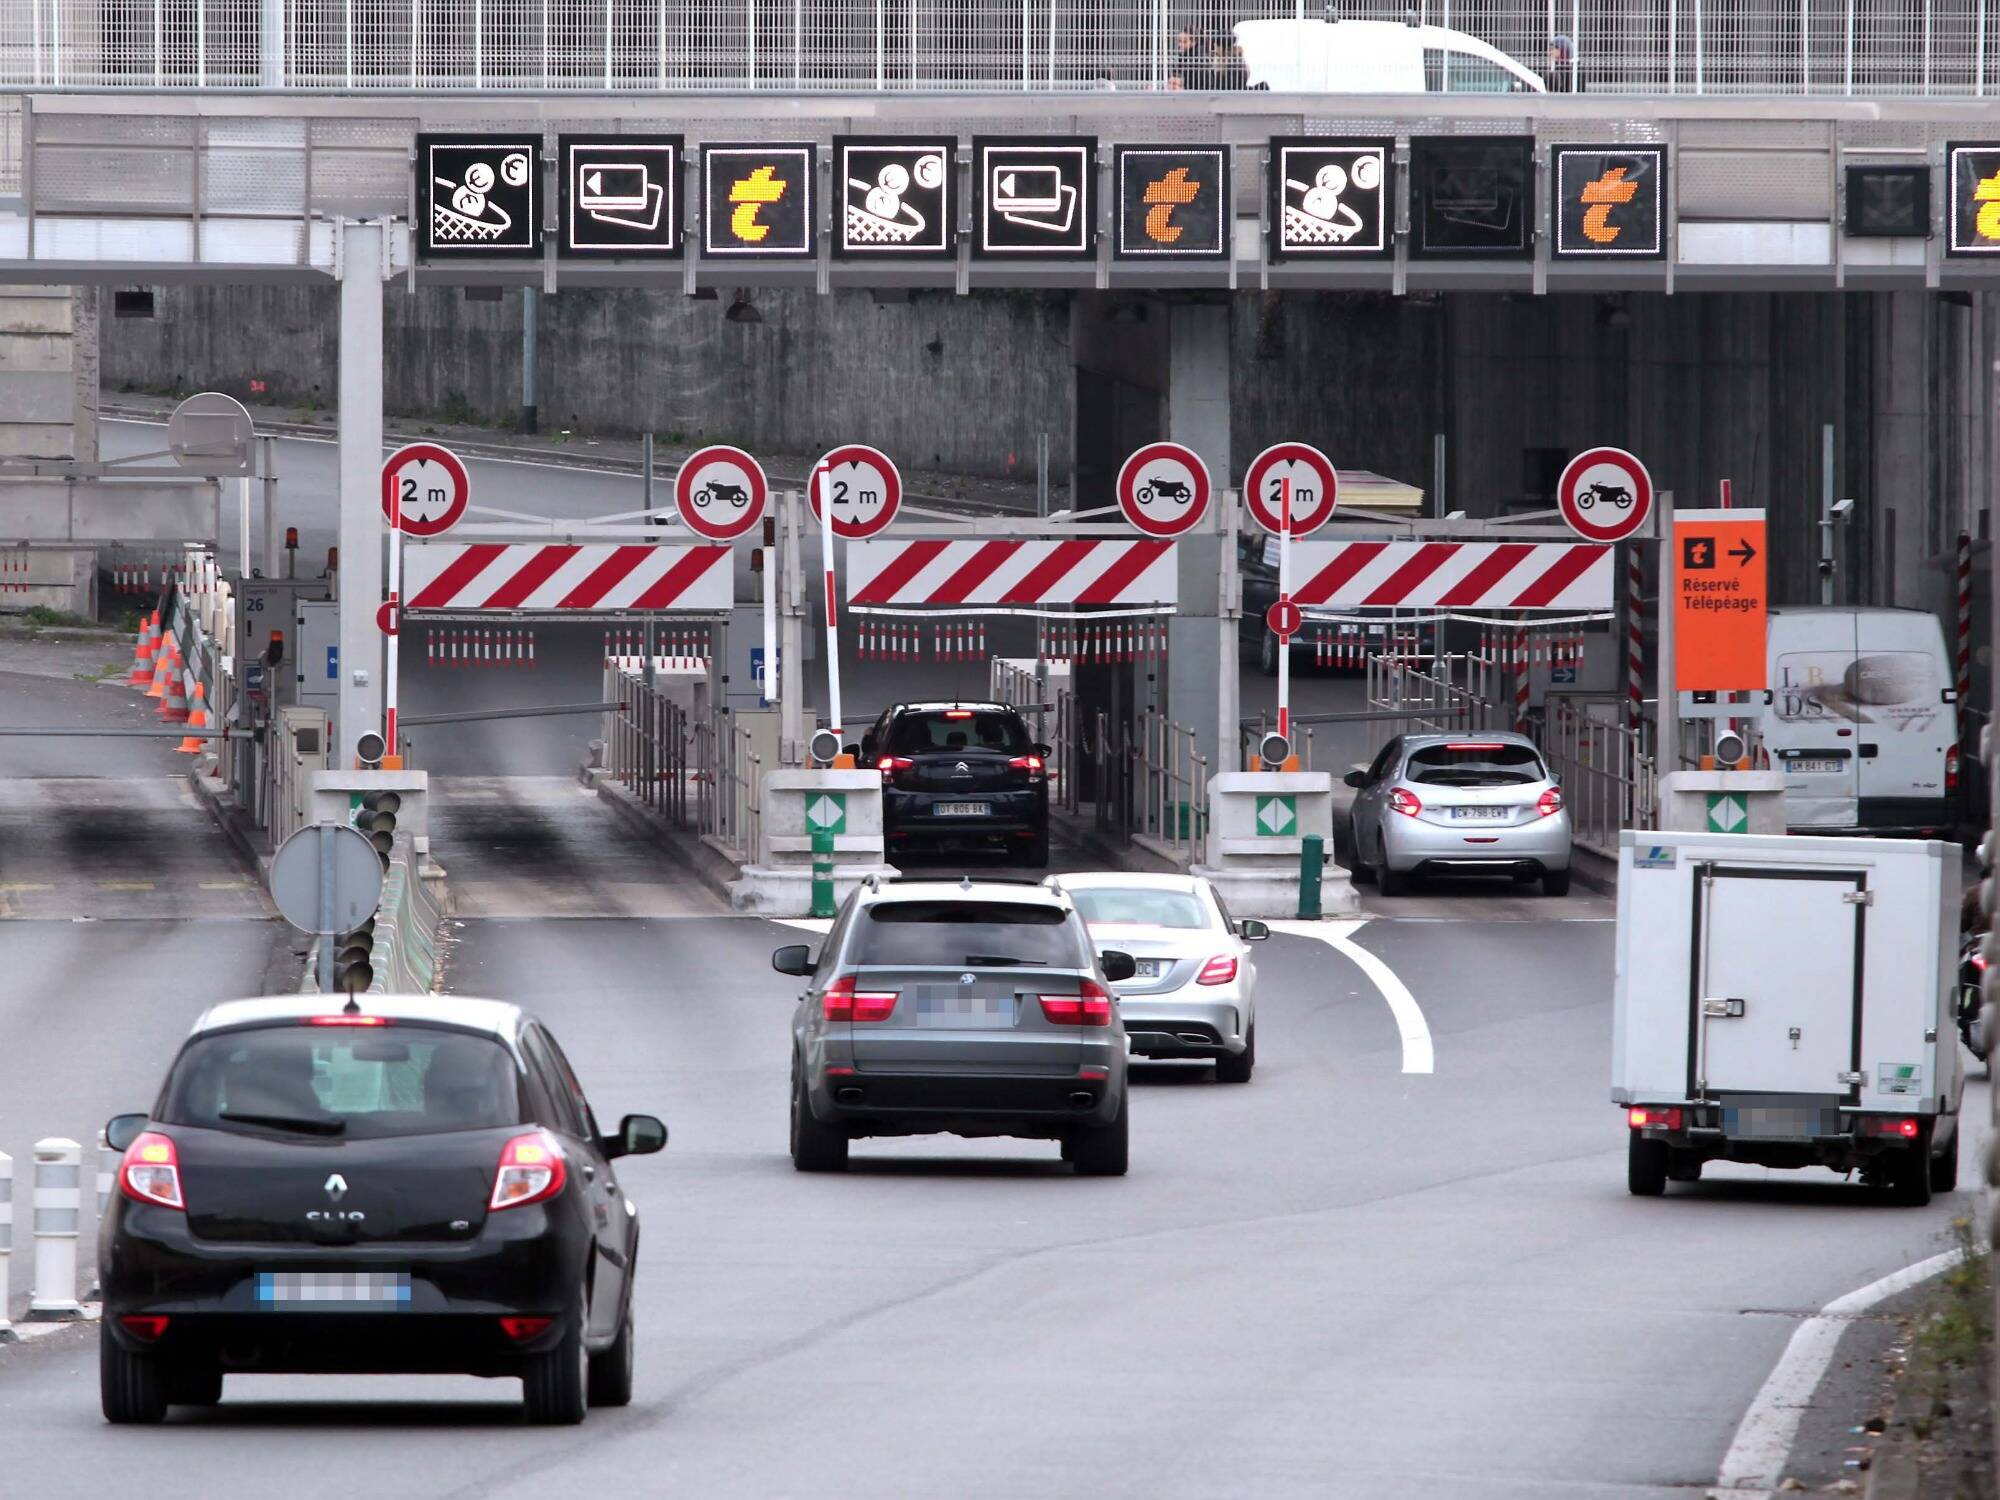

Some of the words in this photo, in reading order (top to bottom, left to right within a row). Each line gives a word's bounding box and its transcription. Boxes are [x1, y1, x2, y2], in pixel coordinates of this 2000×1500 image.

[402, 479, 418, 501] 2
[428, 489, 446, 501] m
[833, 481, 849, 504] 2
[860, 490, 877, 504] m
[1296, 488, 1314, 502] m
[1683, 577, 1740, 592] Réservé
[247, 598, 264, 612] 26
[1684, 595, 1758, 613] Télépéage
[306, 1211, 365, 1220] CLIO
